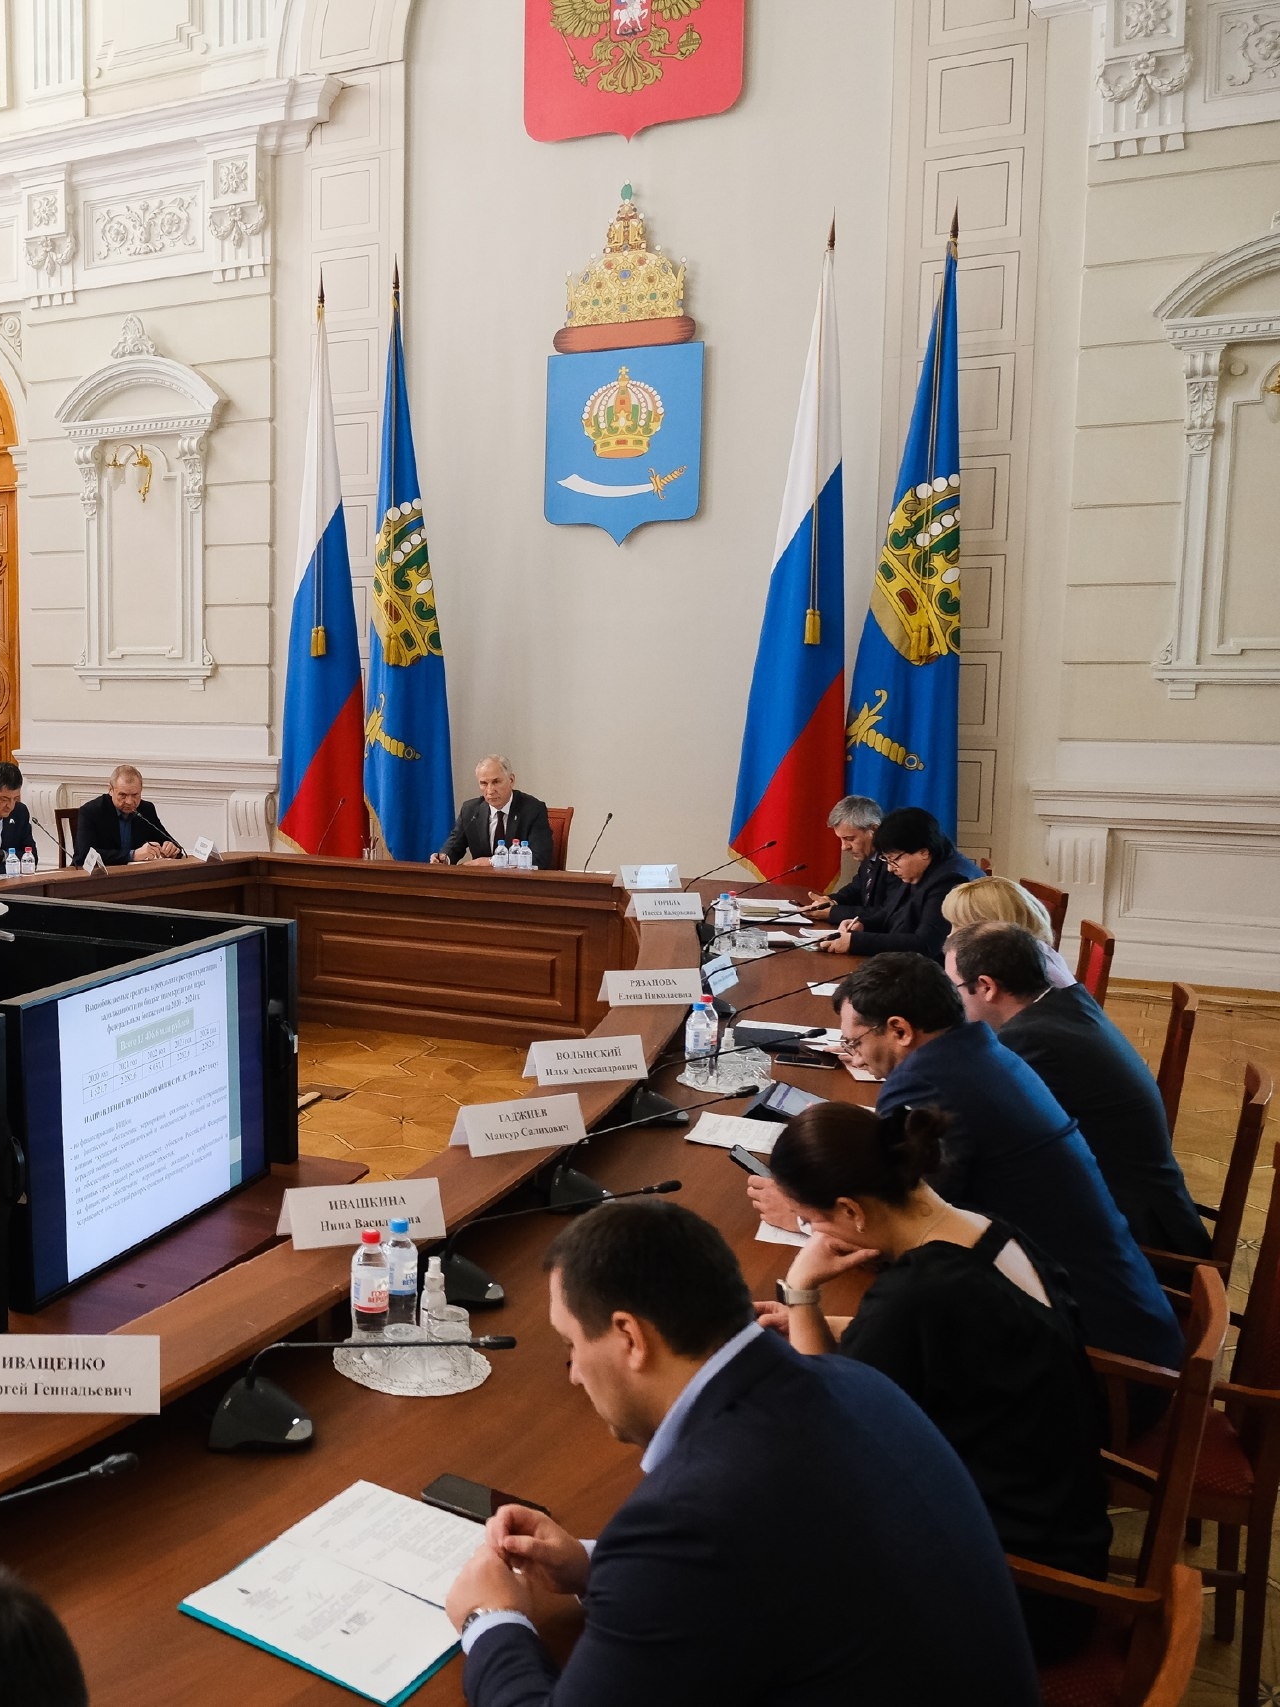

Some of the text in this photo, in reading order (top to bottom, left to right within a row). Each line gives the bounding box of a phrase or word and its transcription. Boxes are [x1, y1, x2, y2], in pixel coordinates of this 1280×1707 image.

[630, 979, 678, 987] РЯЗАНОВА
[618, 992, 692, 1000] Елена Николаевна
[556, 1046, 622, 1061] ВОЛЫНСКИЙ
[545, 1063, 639, 1077] Илья Александрович
[498, 1108, 548, 1123] ГАДЖИЕВ
[484, 1123, 570, 1142] Мансур Салихович
[328, 1195, 407, 1211] ИВАШКИНА
[320, 1214, 422, 1232] Нина Василна
[2, 1356, 106, 1373] ИВАЩЕНКО
[33, 1382, 133, 1397] Геннадьевич
